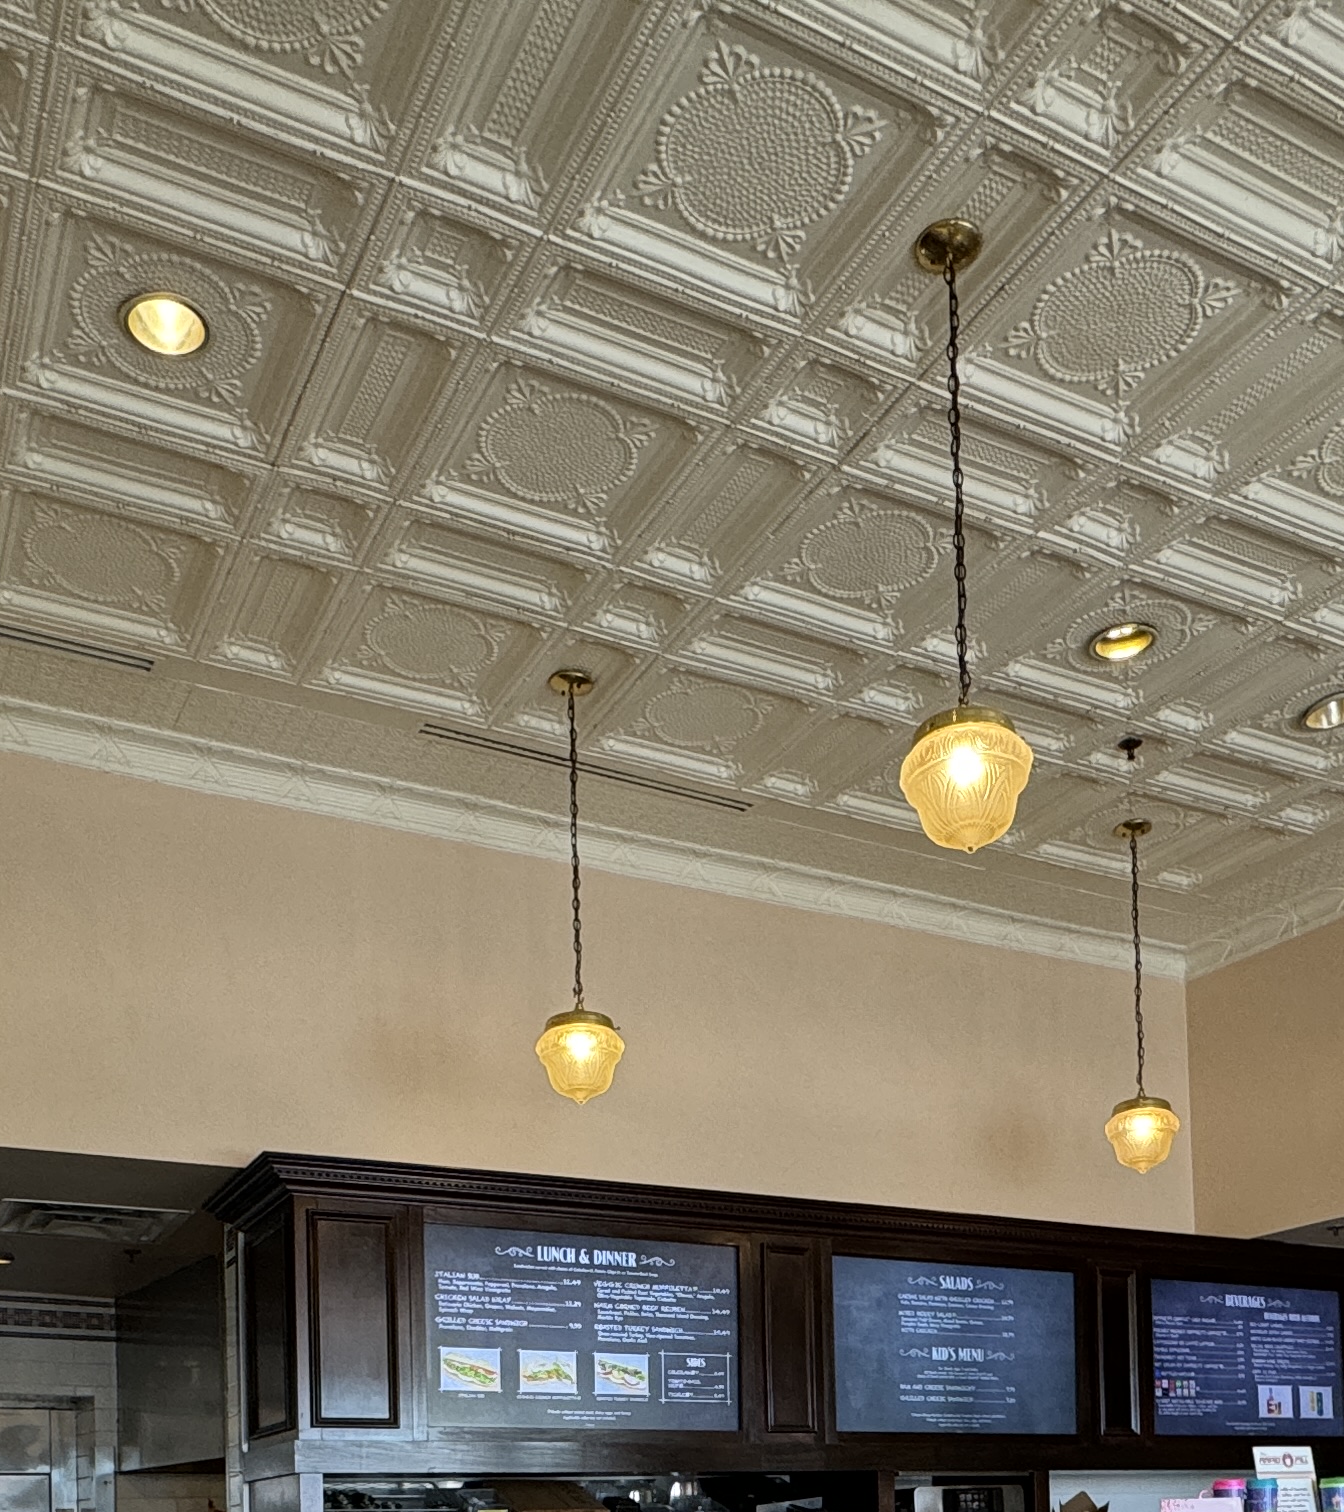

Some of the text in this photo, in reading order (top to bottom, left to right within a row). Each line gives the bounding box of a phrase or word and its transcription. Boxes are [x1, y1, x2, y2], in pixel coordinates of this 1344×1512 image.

[537, 1245, 638, 1267] LUNCH & DINNER
[434, 1271, 465, 1279] ITALIAN
[939, 1275, 973, 1290] SALADS
[468, 1295, 489, 1303] SALAD
[1225, 1294, 1266, 1309] BEVERAGES
[932, 1346, 984, 1362] KID'S MENU
